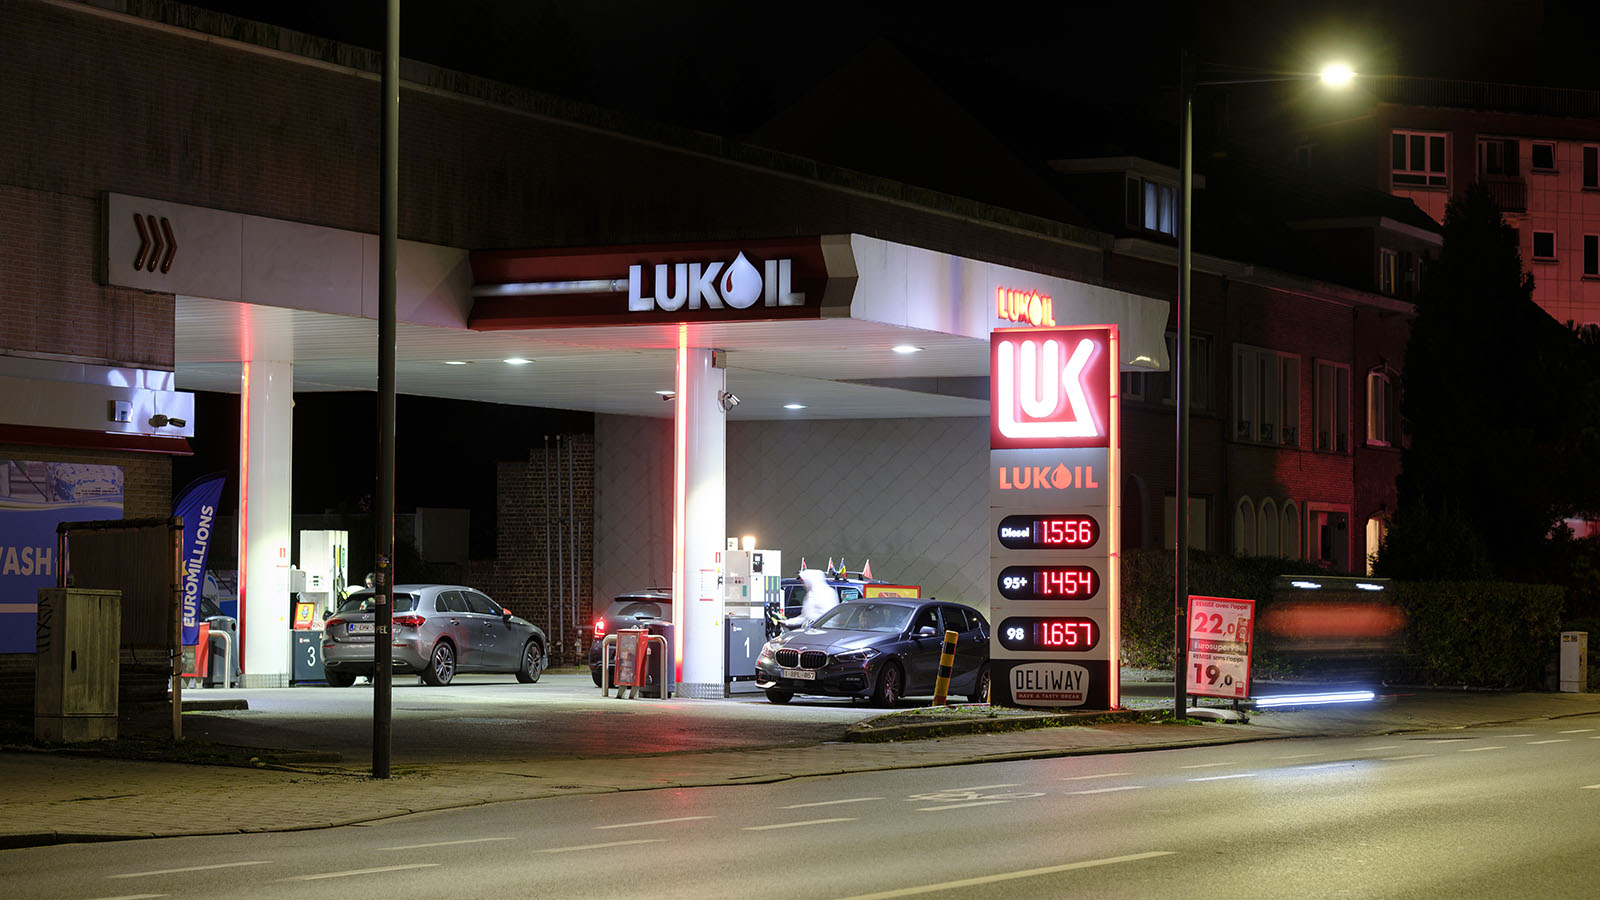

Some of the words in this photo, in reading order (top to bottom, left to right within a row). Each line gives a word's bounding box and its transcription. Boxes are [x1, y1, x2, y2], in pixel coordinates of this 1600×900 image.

[628, 250, 806, 312] LUKOIL
[997, 286, 1056, 327] LUKOIL
[998, 338, 1101, 438] LUK
[999, 462, 1099, 490] LUKOIL
[1001, 526, 1030, 538] Diesel
[1042, 520, 1092, 544] 1.556
[183, 504, 214, 628] EUROMILLIONS
[1003, 576, 1028, 590] 95+
[1042, 571, 1092, 595] 1.454
[1006, 627, 1025, 641] 98
[1042, 622, 1092, 646] 1.657
[1194, 612, 1235, 637] 22,0
[307, 646, 316, 667] 3
[744, 637, 750, 659] 1
[1193, 653, 1212, 661] REMISE
[1194, 663, 1233, 688] 19,0
